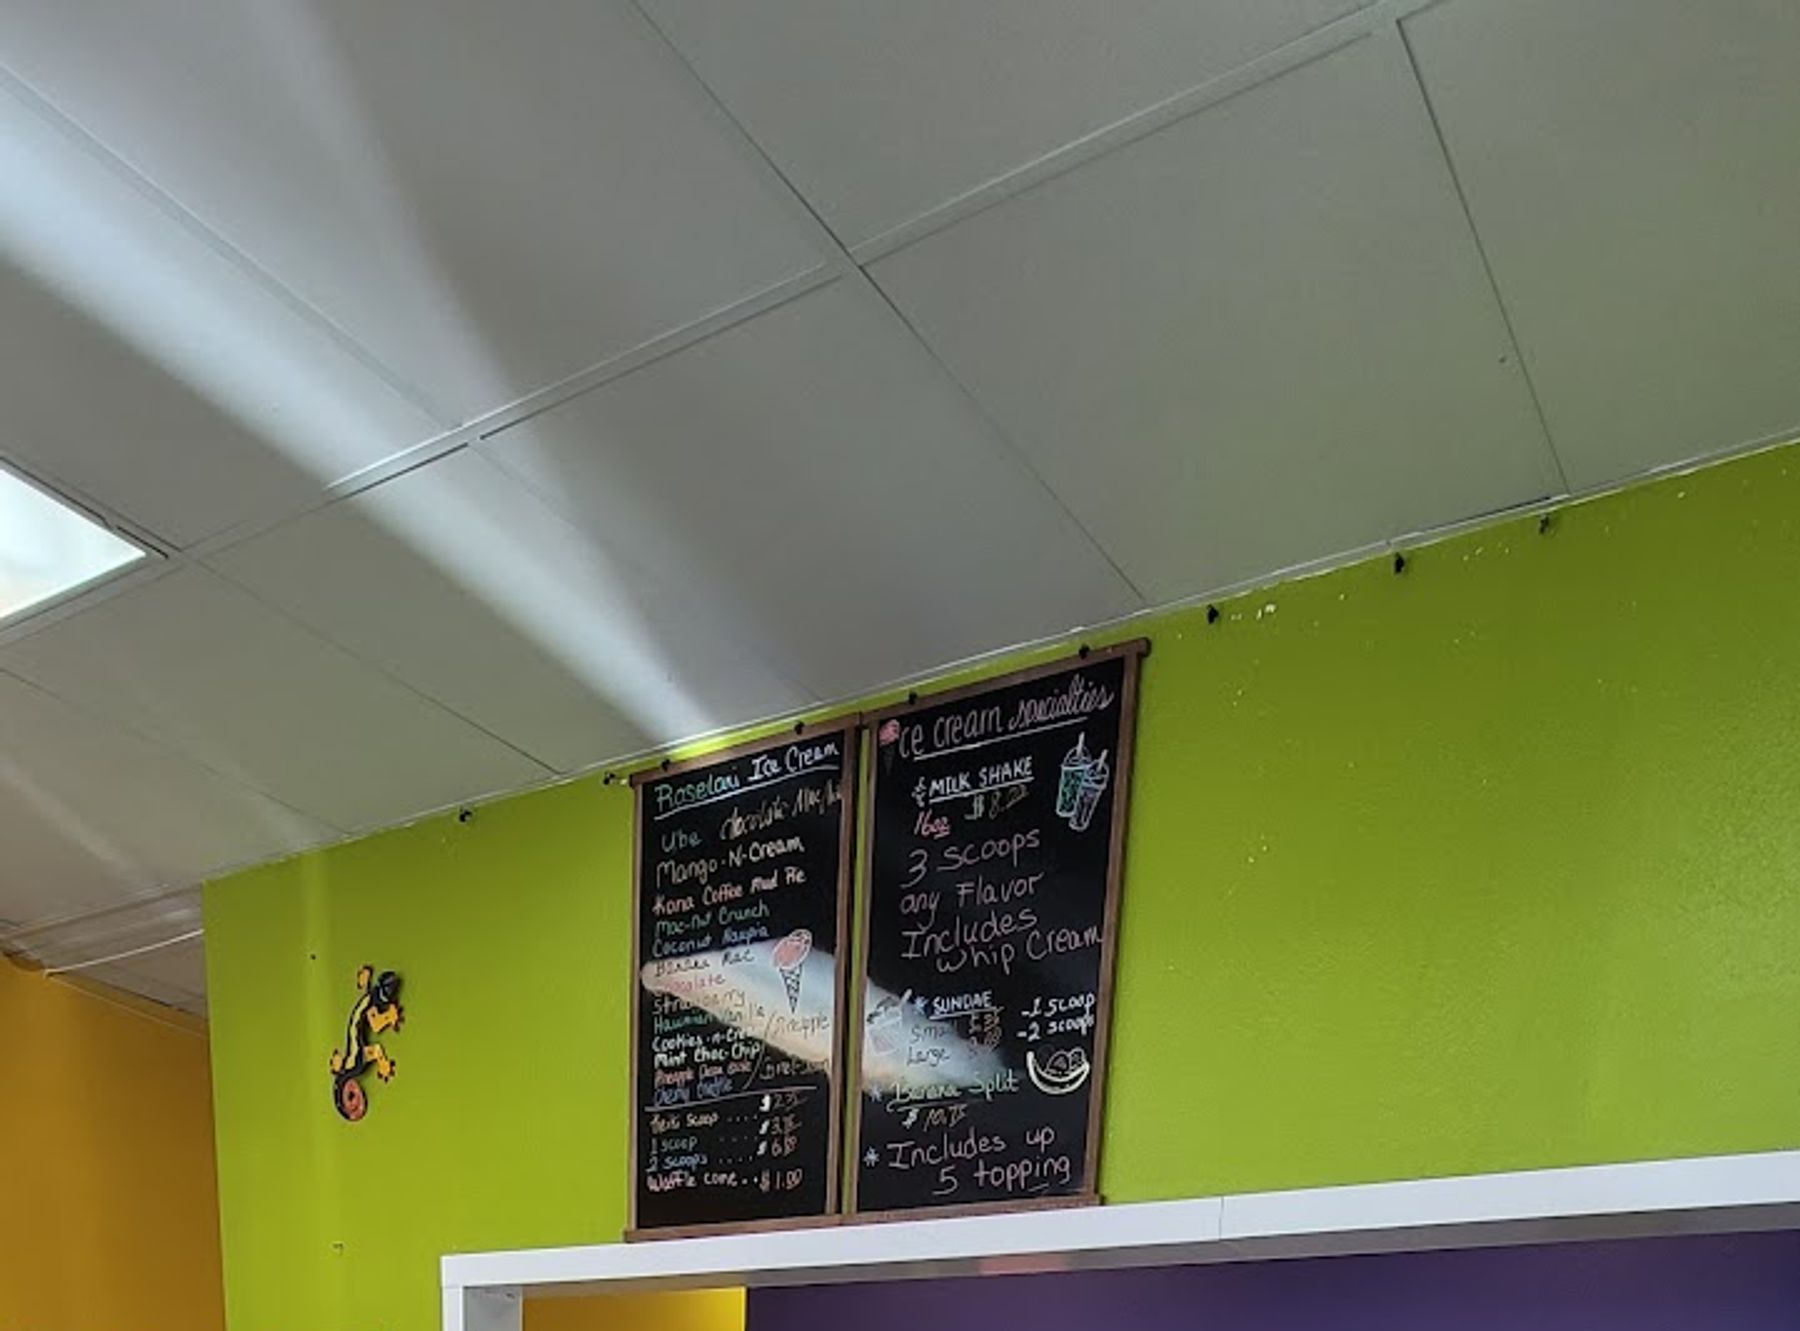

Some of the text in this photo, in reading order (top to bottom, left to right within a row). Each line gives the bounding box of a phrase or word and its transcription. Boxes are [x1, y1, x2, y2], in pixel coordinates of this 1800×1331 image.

[747, 755, 781, 780] Ice
[786, 741, 840, 772] Cream
[928, 756, 1033, 797] MILK SHAKE
[661, 828, 702, 852] Ube
[901, 849, 928, 888] 3
[956, 872, 1045, 907] Flavor
[901, 907, 1038, 959] Includes
[933, 990, 994, 1015] SUNDAE
[654, 1050, 687, 1069] Mint
[968, 1068, 1020, 1101] Split
[887, 1126, 1056, 1170] Includes up
[933, 1155, 1070, 1195] 5 topping
